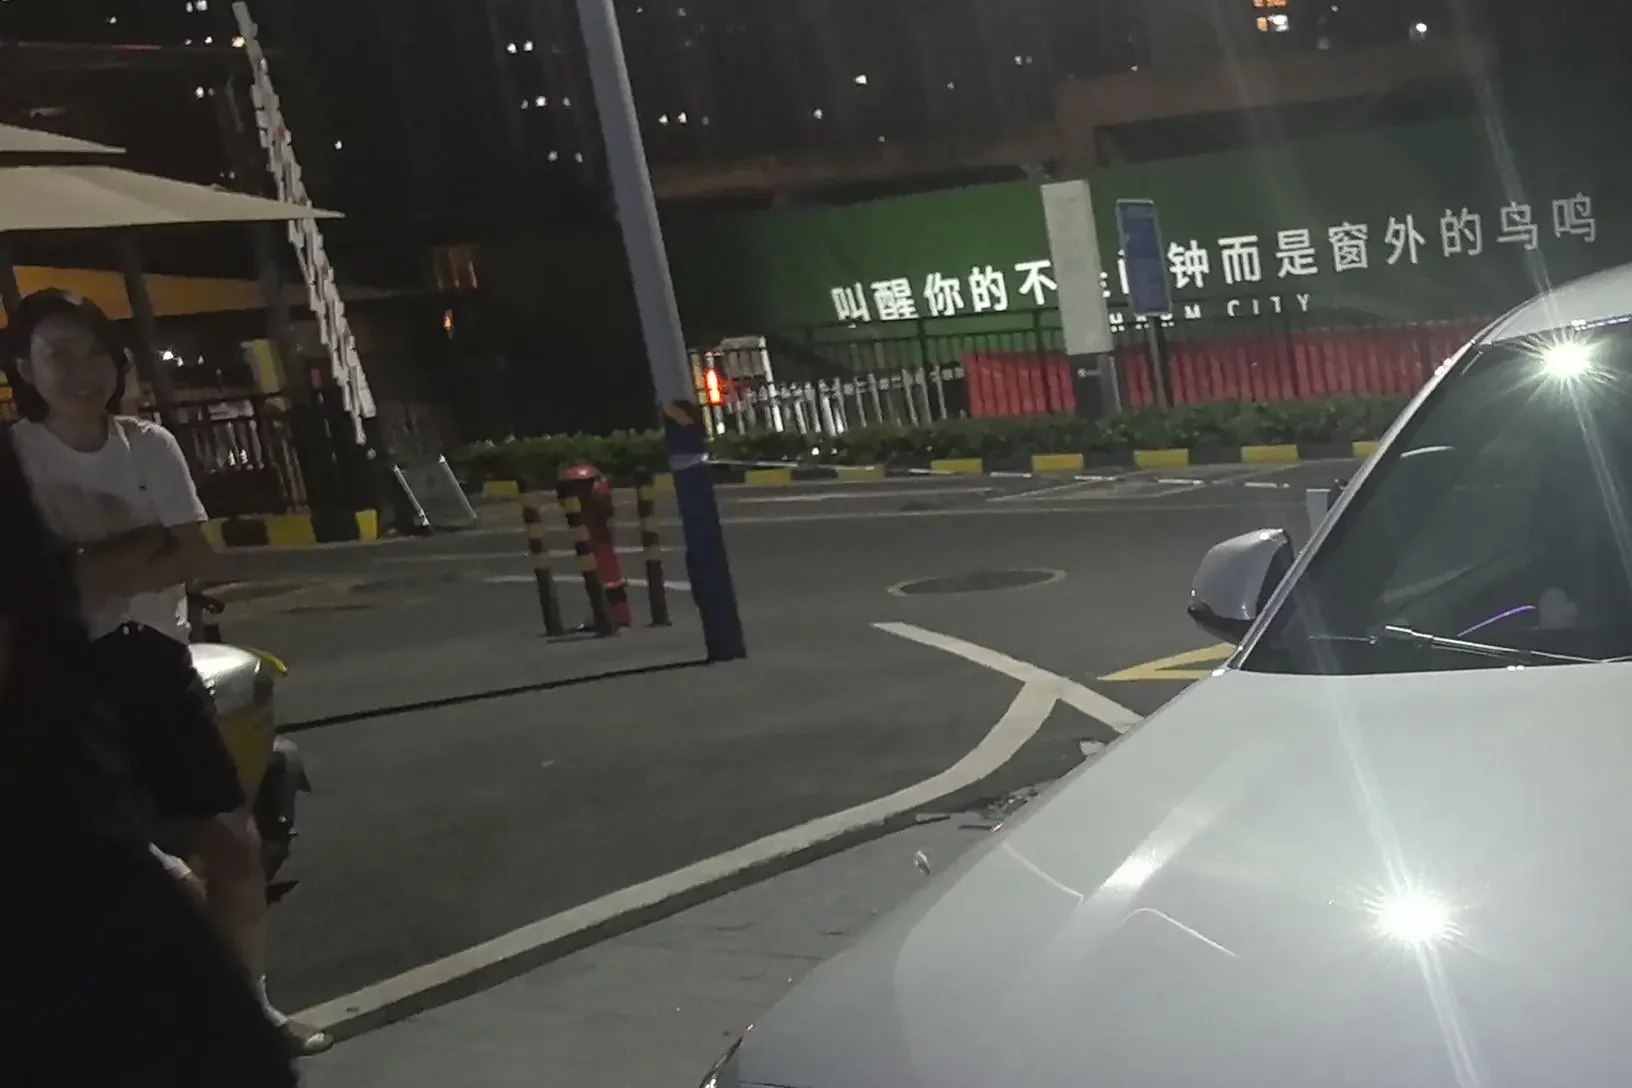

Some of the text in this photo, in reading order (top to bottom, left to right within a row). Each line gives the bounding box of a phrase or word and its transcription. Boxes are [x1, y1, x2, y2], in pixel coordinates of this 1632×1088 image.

[830, 191, 1599, 326] 叫醒你的不钟而是窗外的鸟鸣
[1227, 293, 1310, 317] CITY
